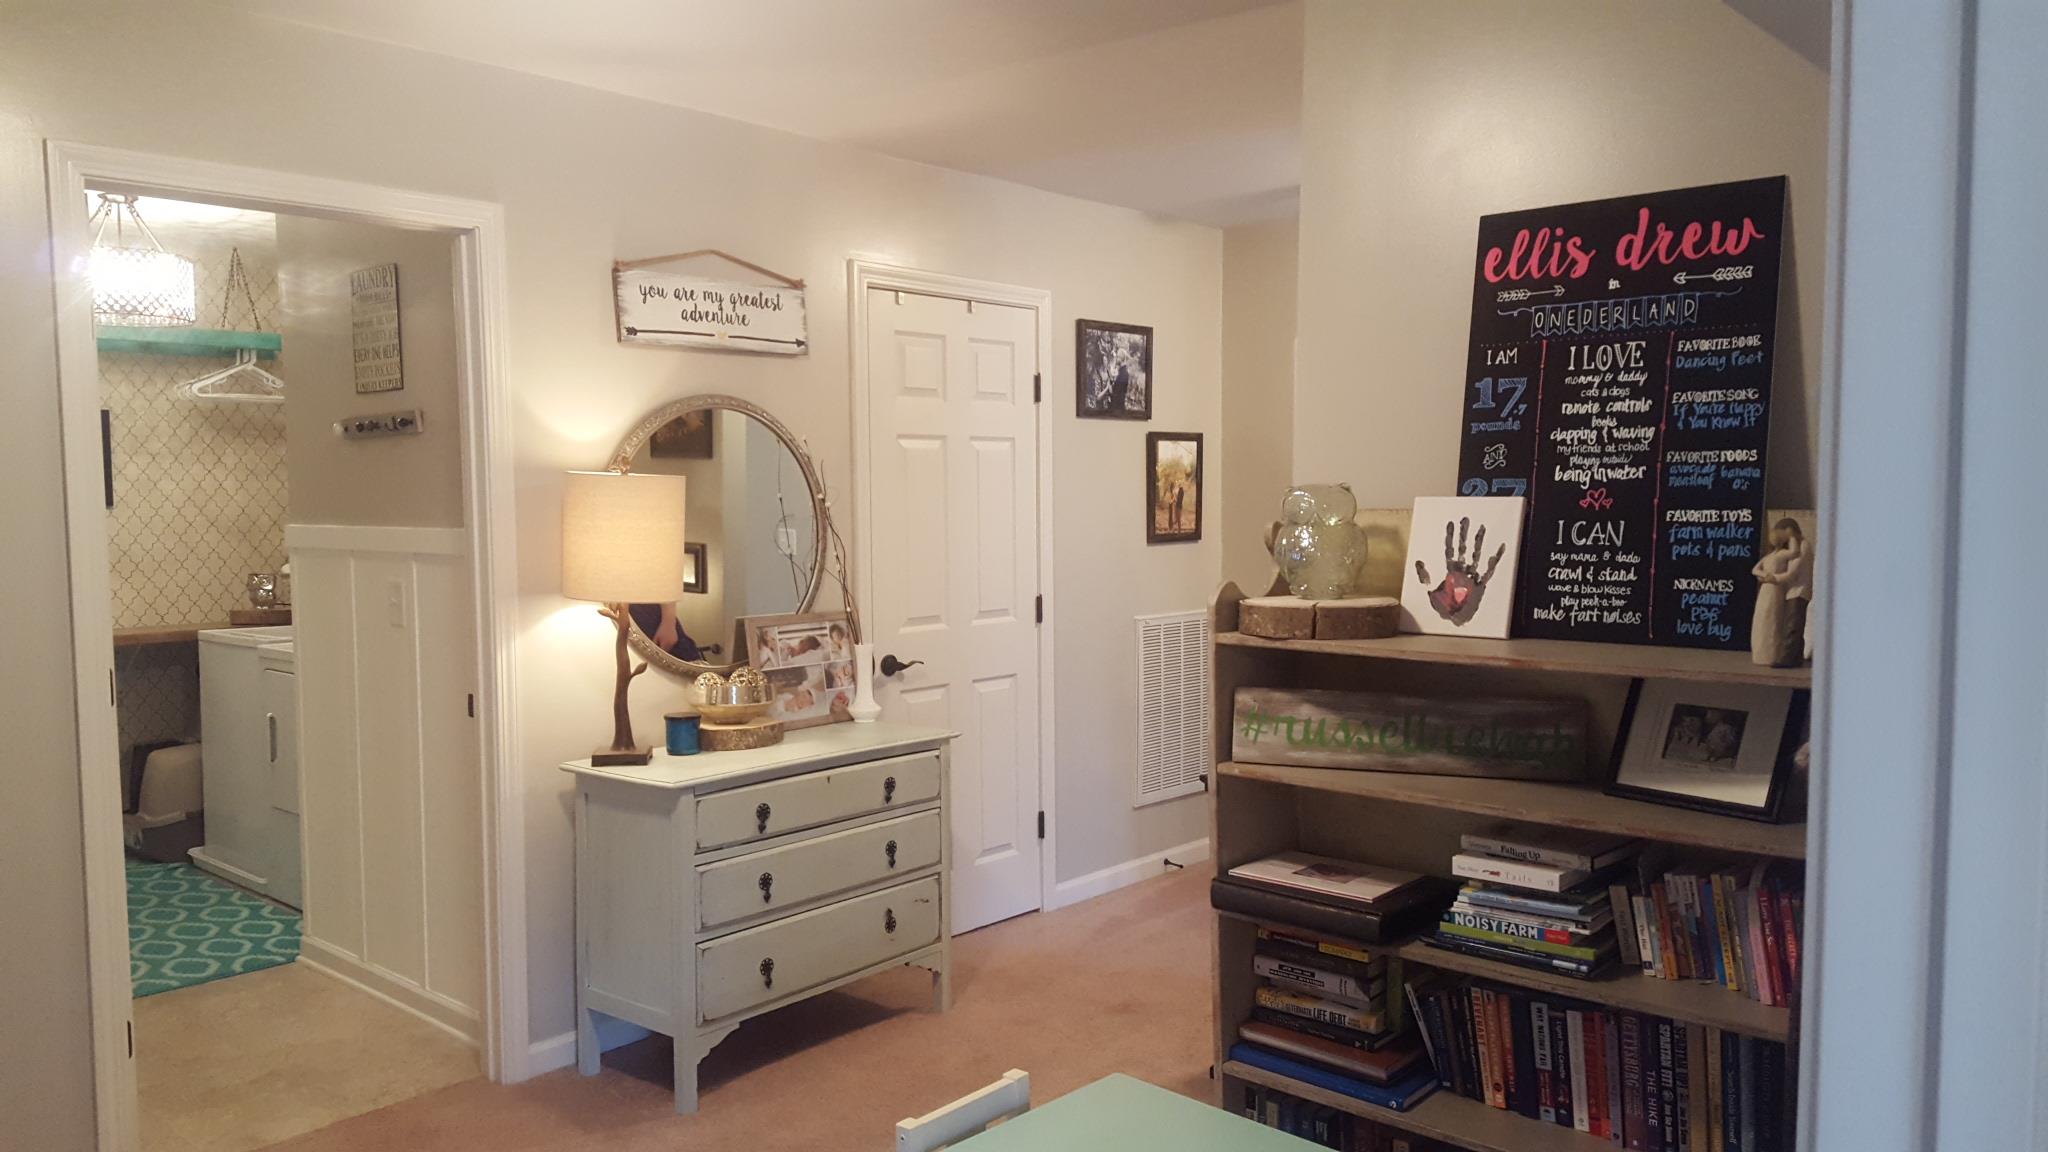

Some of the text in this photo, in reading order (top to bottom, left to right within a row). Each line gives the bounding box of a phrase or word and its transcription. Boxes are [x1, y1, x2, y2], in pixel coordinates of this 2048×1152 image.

[1483, 207, 1765, 283] ellis drew
[351, 265, 395, 297] LAUNDRY
[1608, 278, 1621, 290] in
[639, 283, 784, 312] you are my greatest
[681, 303, 751, 327] adventure
[1534, 299, 1696, 329] ONEDERLAND
[1677, 334, 1762, 352] FAVORITE BOOK
[1486, 347, 1518, 366] I AM
[1567, 340, 1646, 371] I LOVE
[1675, 352, 1726, 372] Dancing
[1565, 372, 1602, 388] mommy
[1617, 370, 1648, 386] daddy
[1580, 387, 1599, 398] cats
[1609, 386, 1631, 398] dogs
[1672, 387, 1760, 404] FAVORITE SONG
[1561, 396, 1653, 415] remote controls
[1470, 417, 1521, 434] pounds
[1591, 415, 1618, 428] books
[1689, 416, 1708, 429] You
[1550, 426, 1598, 445] clapping
[1612, 425, 1656, 443] waving
[1605, 443, 1617, 452] at
[1618, 441, 1650, 452] school
[1570, 453, 1633, 469] playing outside
[1666, 449, 1758, 463] FAVORITE FOODS
[1554, 464, 1647, 489] being in water
[1721, 465, 1761, 478] banana
[1666, 508, 1753, 522] FAVORITE TOYS
[1556, 519, 1625, 547] I CAN
[1668, 522, 1754, 543] farm walker
[1550, 551, 1569, 566] say
[1615, 551, 1641, 563] dada
[1717, 544, 1751, 562] pans
[1547, 565, 1582, 581] crawl
[1598, 566, 1638, 581] stand
[1548, 584, 1572, 593] wave
[1581, 584, 1603, 594] blow
[1673, 578, 1734, 592] NICKNAMES
[1561, 595, 1579, 610] play
[1681, 592, 1729, 608] peanut
[1533, 603, 1642, 627] make fart noises
[1677, 619, 1732, 642] love bug
[1500, 845, 1527, 858] Falling
[1528, 851, 1541, 861] Up
[1505, 871, 1532, 883] Tails
[1455, 913, 1498, 932] NOISY
[1501, 921, 1538, 939] FARM
[1312, 1006, 1328, 1023] LIFE
[1328, 1010, 1347, 1026] DEBT
[1536, 1007, 1545, 1022] WHY
[1623, 1015, 1640, 1088] GETTYSBURG
[1658, 1023, 1673, 1088] SPARTAN FIT!
[1646, 1070, 1658, 1127] THE HIKE
